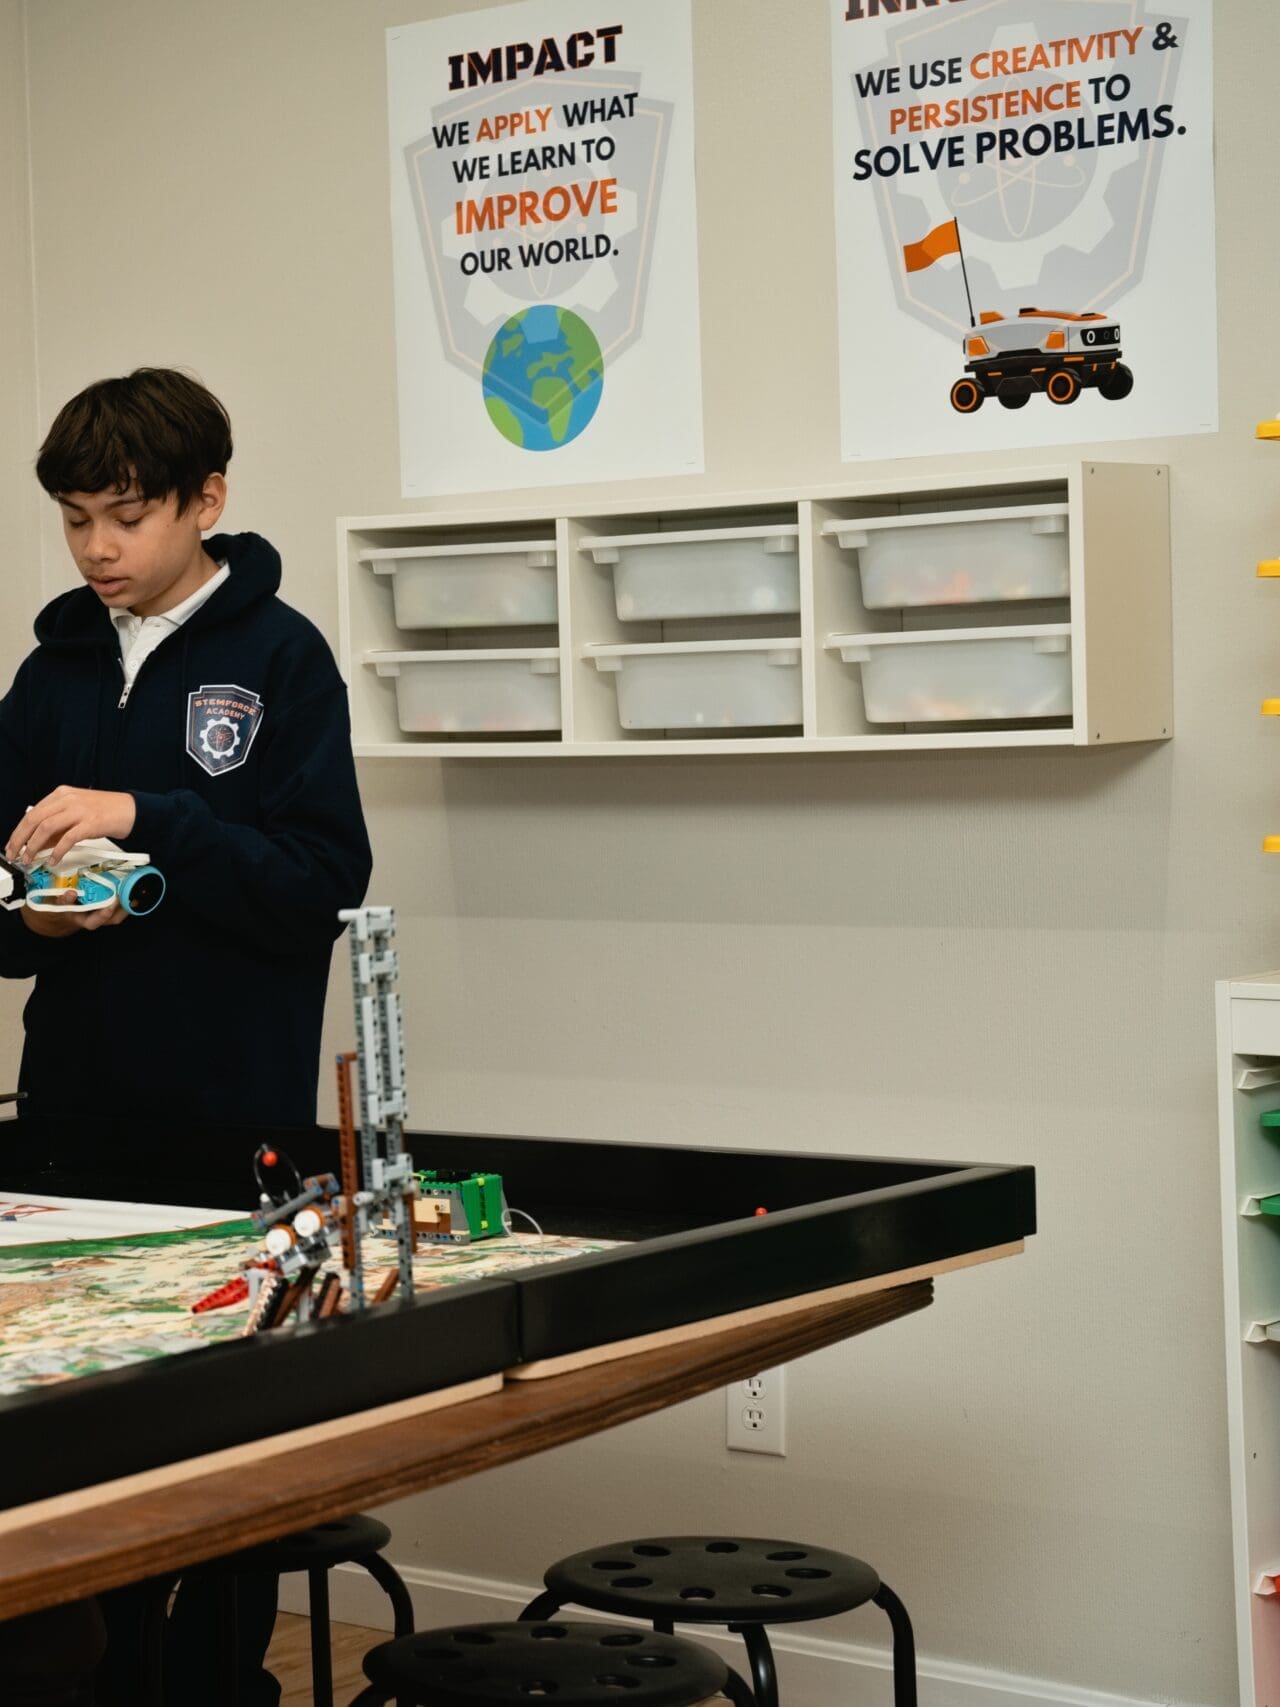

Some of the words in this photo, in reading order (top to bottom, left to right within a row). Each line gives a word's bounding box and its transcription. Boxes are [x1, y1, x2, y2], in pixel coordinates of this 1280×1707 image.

[448, 24, 623, 91] IMPACT
[855, 67, 901, 98] WE
[909, 57, 962, 90] USE
[969, 26, 1144, 80] CREATIVITY
[1151, 22, 1179, 51] &
[432, 121, 470, 149] WE
[475, 106, 552, 142] APPLY
[562, 92, 638, 128] WHAT
[889, 81, 1081, 135] PERSISTENCE
[1088, 73, 1131, 105] TO
[452, 155, 490, 183] WE
[497, 141, 576, 176] LEARN
[582, 136, 616, 164] TO
[852, 135, 965, 181] SOLVE
[975, 104, 1187, 164] PROBLEMS.
[455, 178, 618, 235] IMPROVE
[460, 246, 513, 276] OUR
[518, 233, 619, 268] WORLD.
[206, 707, 245, 720] ACADEMY
